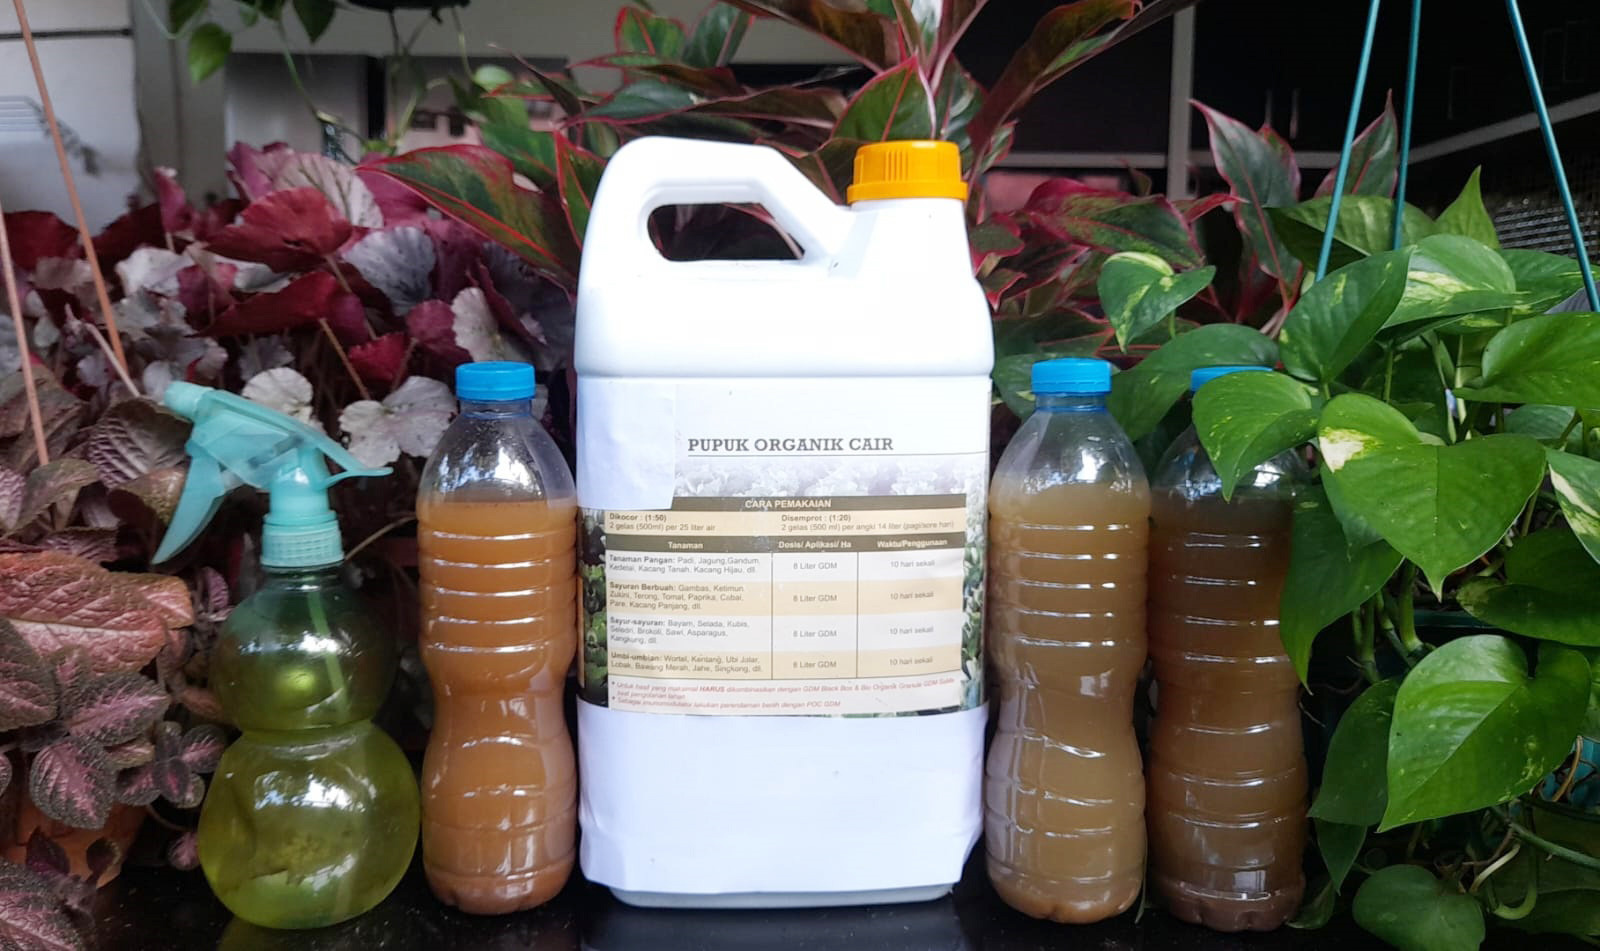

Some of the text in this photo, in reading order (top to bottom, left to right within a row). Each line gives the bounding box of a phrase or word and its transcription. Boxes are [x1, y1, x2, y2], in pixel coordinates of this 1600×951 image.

[688, 437, 894, 451] PUPUK ORGANIK CAIR
[745, 499, 832, 509] CARA PEMAKAIAN
[609, 513, 638, 521] Dikocor
[645, 513, 667, 522] (1:50)
[781, 514, 822, 523] Disemprot
[828, 513, 851, 522] (1:20)
[616, 523, 634, 531] gelas
[636, 523, 664, 532] (500ml)
[665, 524, 678, 532] per
[788, 523, 808, 532] gelas
[841, 524, 855, 532] per
[888, 521, 901, 529] liter
[668, 541, 704, 549] Tanaman
[841, 540, 852, 548] Ha
[609, 554, 642, 563] Tanaman
[644, 556, 675, 565] Pangan:
[915, 559, 935, 567] sekali
[638, 565, 666, 573] Kacang
[693, 566, 722, 574] Kacang
[609, 582, 639, 591] Sayuran
[641, 583, 676, 591] Berbuah:
[800, 594, 816, 602] Liter
[818, 594, 837, 602] GDM
[900, 592, 913, 600] hari
[914, 591, 934, 599] sekali
[629, 601, 656, 610] Kacang
[610, 616, 665, 627] Sayur-sayuran:
[914, 626, 934, 634] sekali
[800, 660, 815, 668] Liter
[817, 660, 837, 668] GDM
[914, 656, 933, 664] sekali
[699, 685, 725, 693] HARUS
